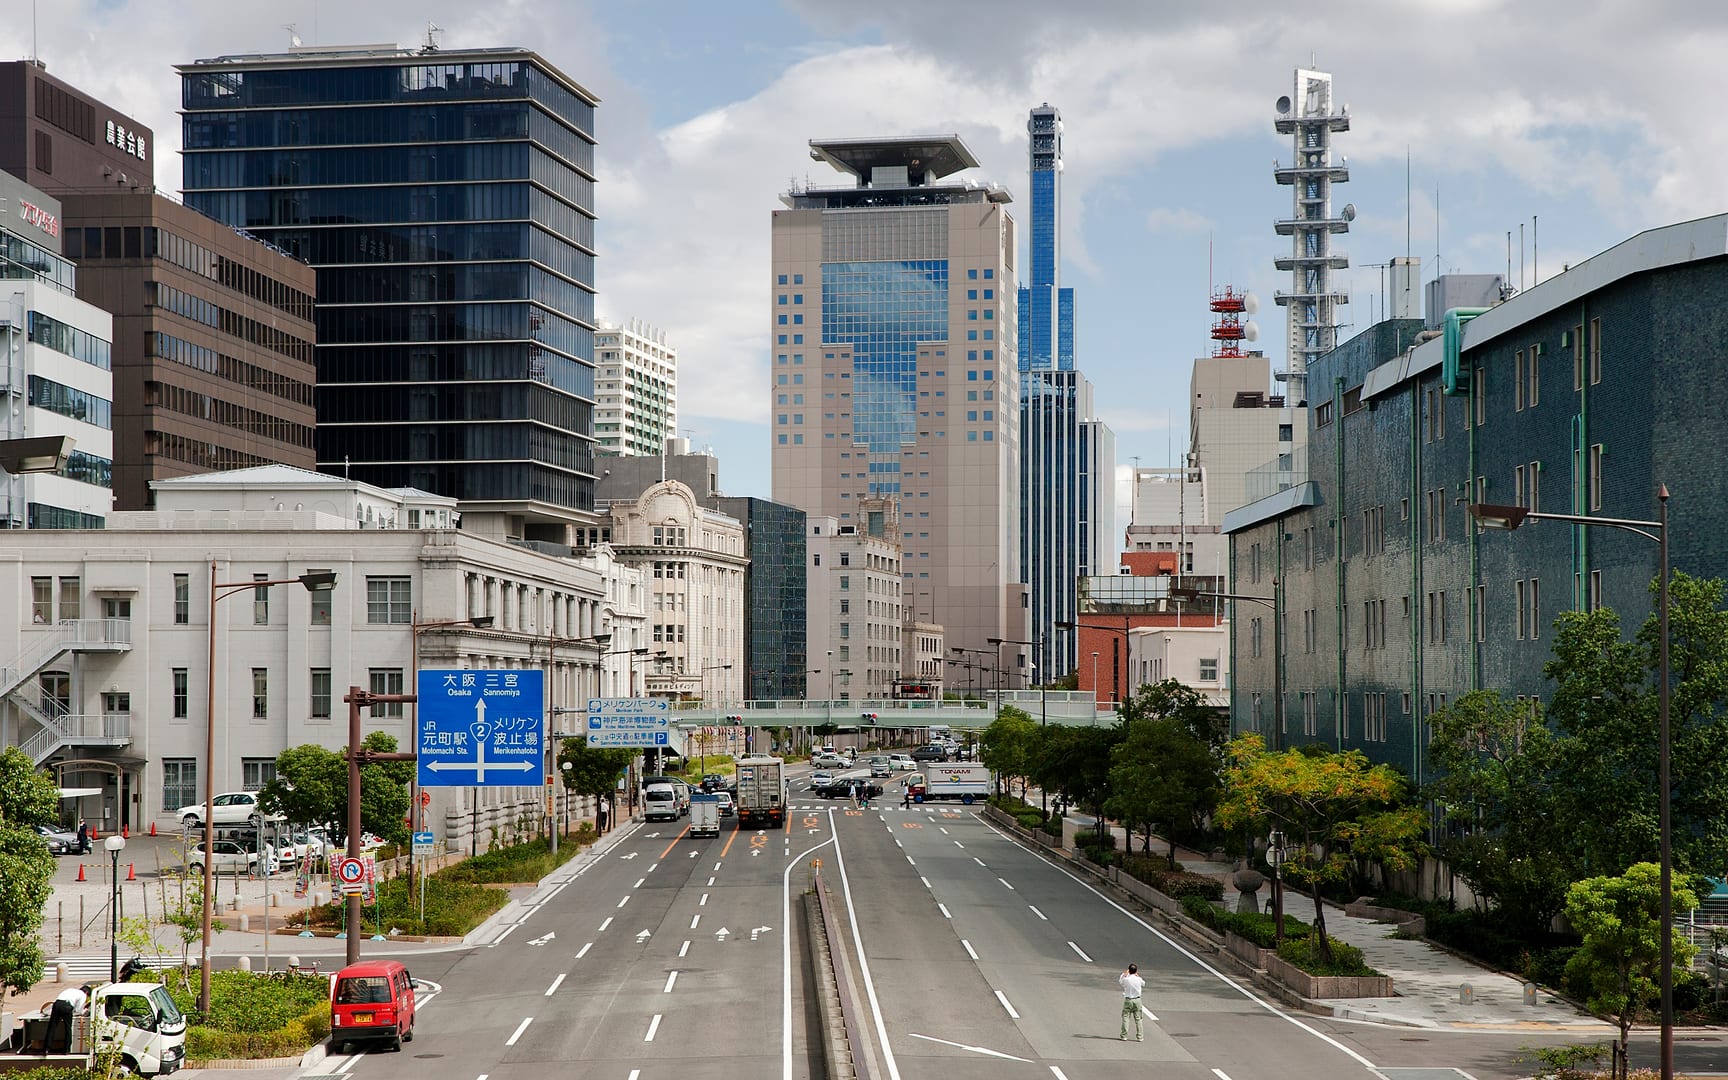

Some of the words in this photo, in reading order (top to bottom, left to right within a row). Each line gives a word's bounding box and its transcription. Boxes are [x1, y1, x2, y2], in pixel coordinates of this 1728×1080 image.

[107, 120, 146, 160] 農業会館
[443, 673, 476, 687] 大阪
[485, 673, 519, 687] 三宮
[447, 688, 472, 696] Osaka
[483, 688, 520, 697] Sannomiya
[603, 700, 657, 708] メリケンパーク
[423, 720, 436, 731] JR
[493, 717, 538, 730] メリケン
[476, 725, 485, 737] 2
[423, 732, 468, 745] 元町駅
[493, 732, 538, 745] 波止場
[657, 733, 665, 744] P
[421, 746, 455, 755] Motomachi
[456, 746, 469, 755] Sta.
[493, 746, 538, 755] Merikenhatoba
